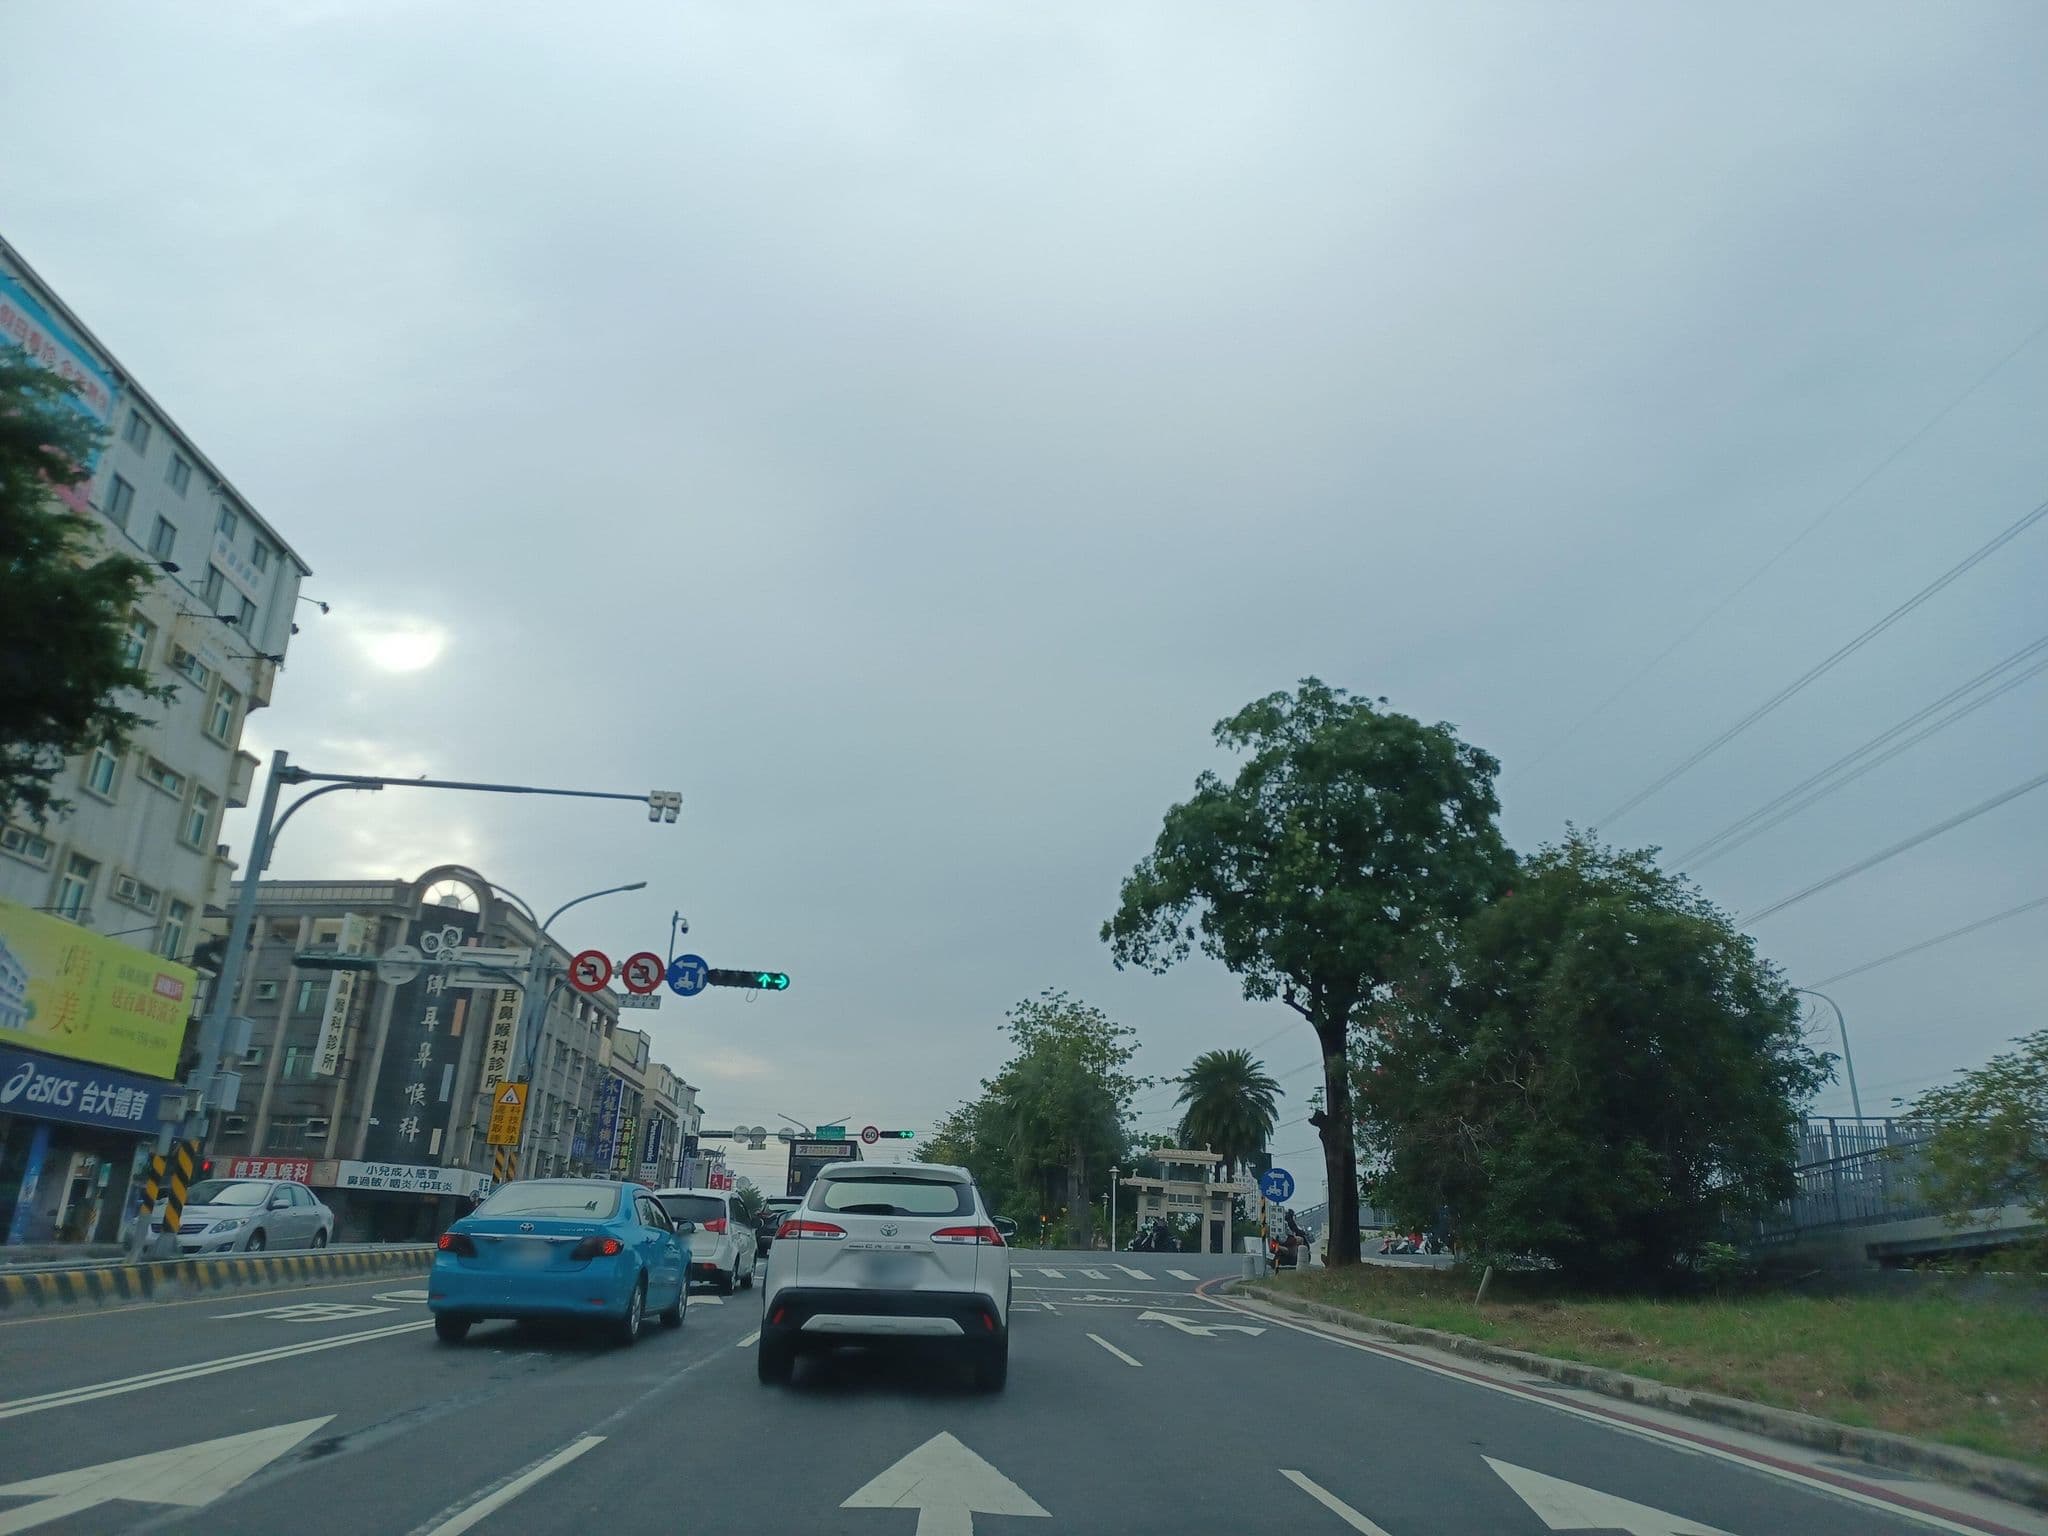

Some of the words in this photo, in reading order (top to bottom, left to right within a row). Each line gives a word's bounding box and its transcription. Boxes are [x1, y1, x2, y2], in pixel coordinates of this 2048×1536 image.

[79, 1080, 149, 1121] 台大體育
[647, 1120, 659, 1161] Panasonic
[865, 1131, 876, 1139] 60
[366, 1165, 440, 1180] 小兒成人感冒
